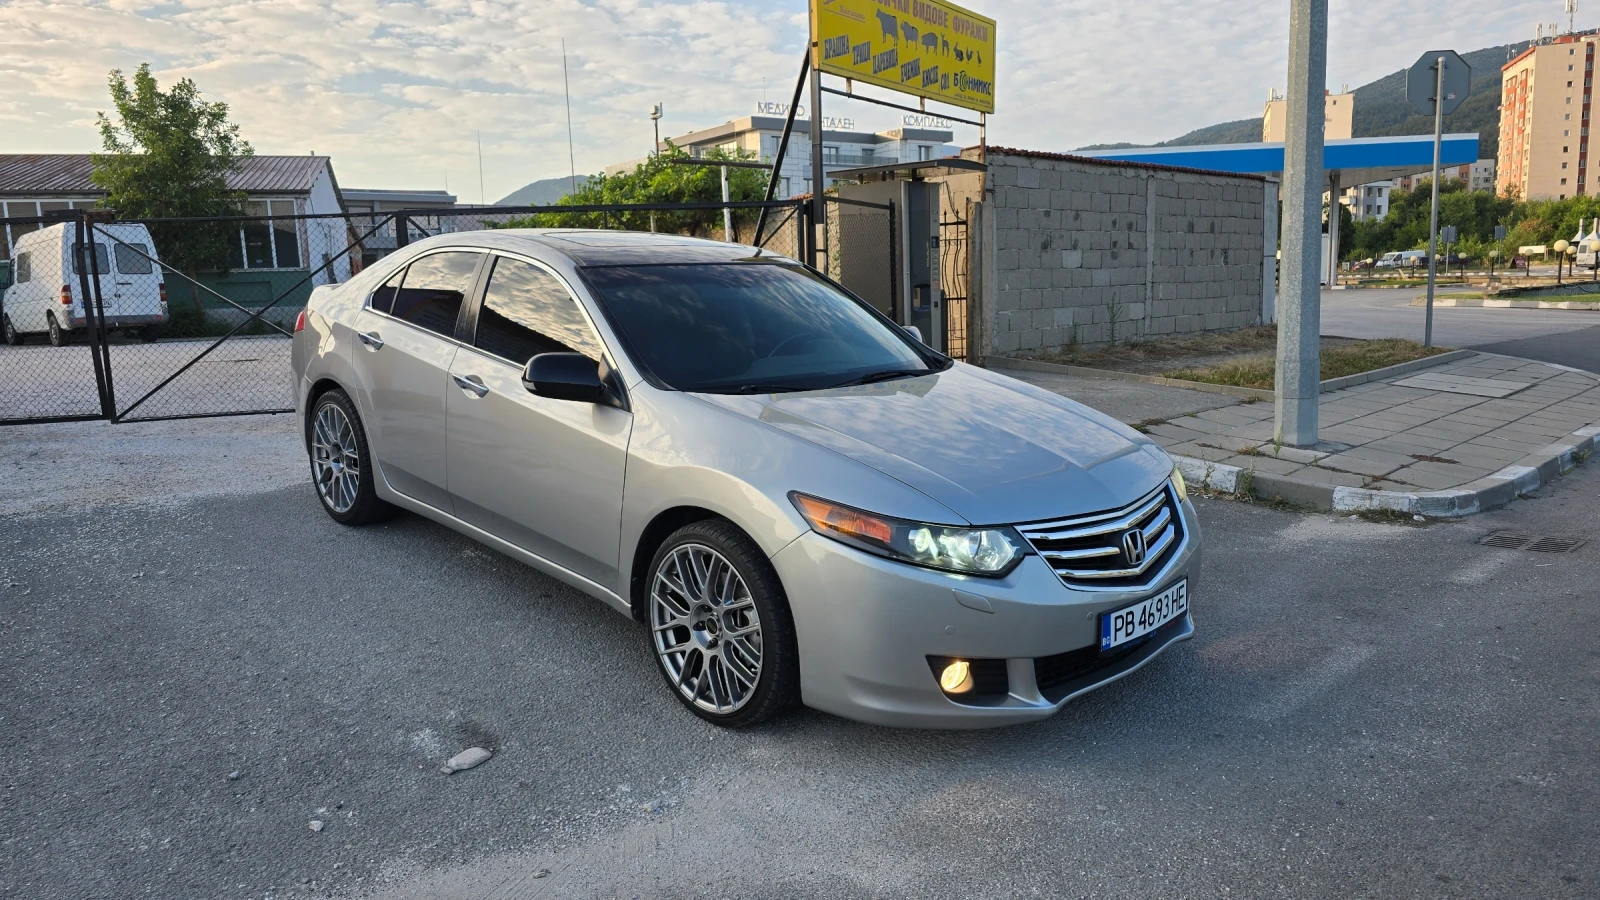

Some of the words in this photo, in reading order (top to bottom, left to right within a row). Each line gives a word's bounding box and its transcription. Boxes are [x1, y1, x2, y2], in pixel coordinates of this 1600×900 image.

[912, 0, 948, 28] ВИДОВЕ
[953, 15, 987, 42] ФУРАЖИ
[824, 35, 849, 60] БРАШНА
[852, 41, 871, 66] ТРИЦИ
[872, 48, 899, 75] ЦАРЕВИЦА
[757, 101, 805, 117] МЕДИО
[903, 114, 953, 129] КОМПЛЕКС
[1114, 611, 1134, 642] PB
[1139, 595, 1169, 630] 4693
[1172, 584, 1184, 614] HE
